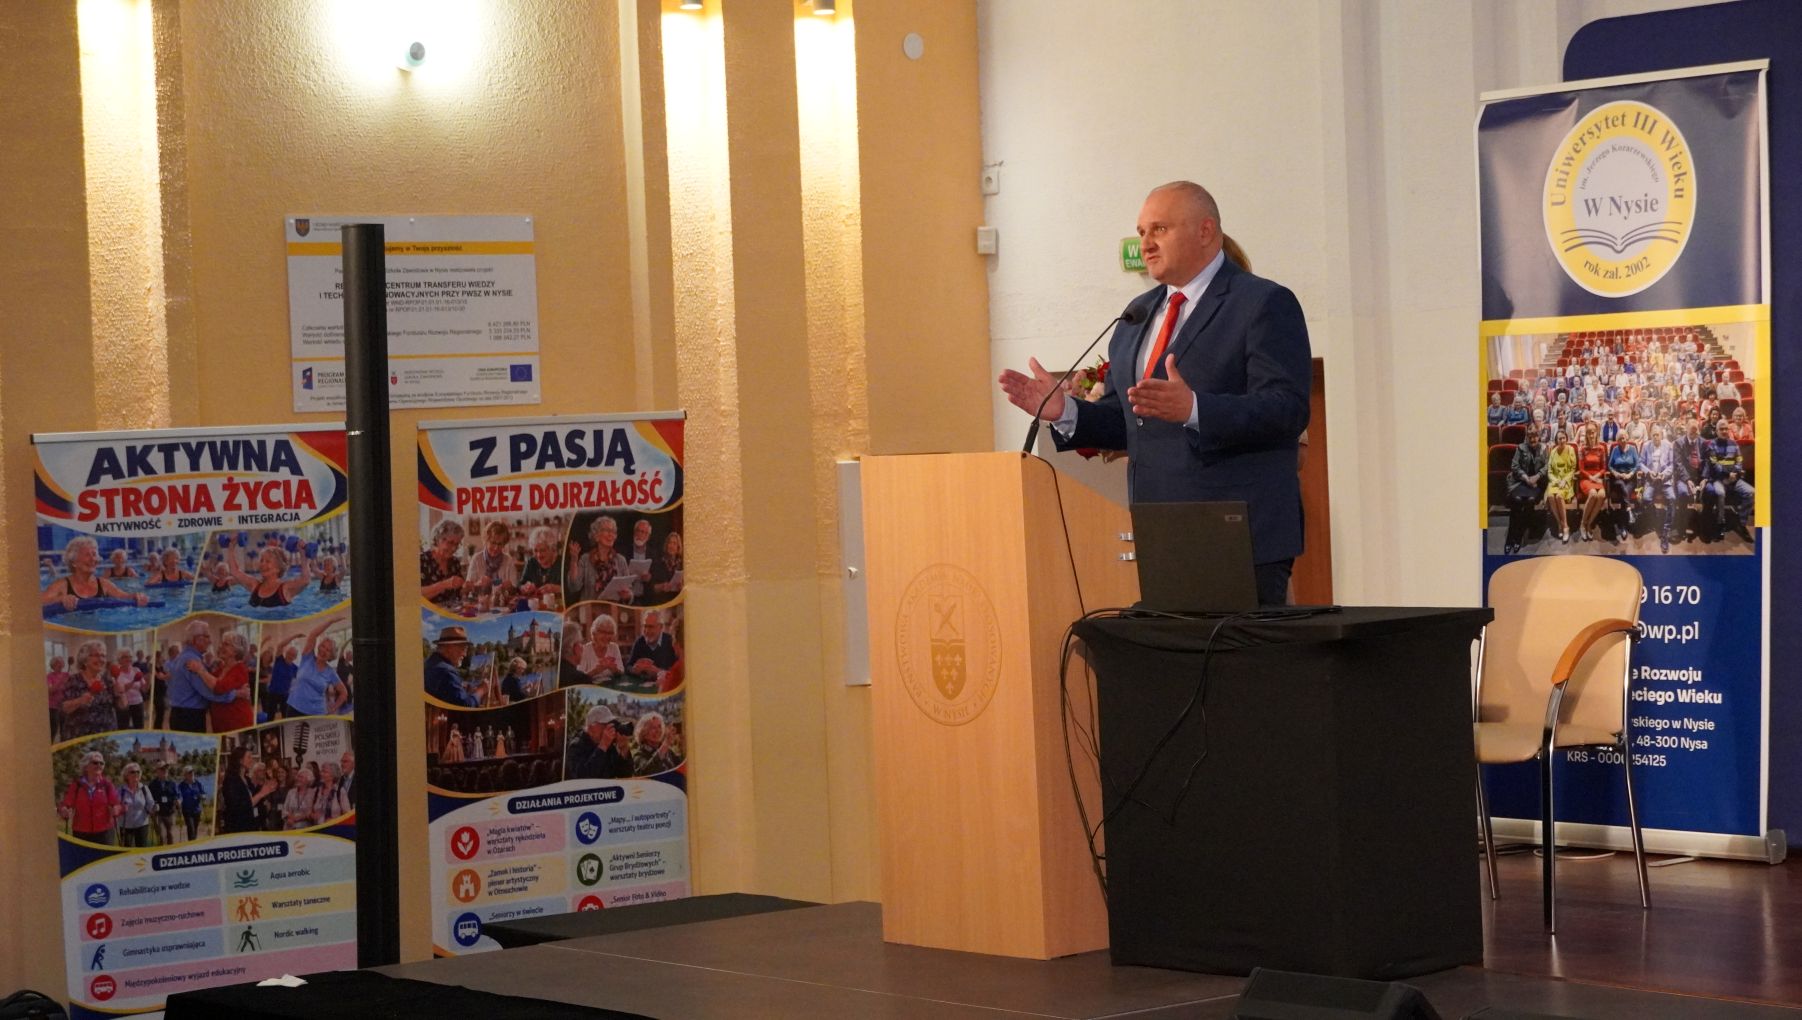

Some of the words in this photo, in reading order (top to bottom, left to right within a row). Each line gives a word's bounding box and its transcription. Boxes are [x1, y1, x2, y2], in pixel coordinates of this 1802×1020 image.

[1551, 113, 1626, 207] Uniwersytet
[1632, 111, 1658, 136] III
[1660, 129, 1688, 199] Wieku
[1583, 198, 1604, 218] W
[1608, 193, 1659, 220] Nysie
[1127, 244, 1139, 258] W
[1584, 260, 1601, 277] rok
[1625, 256, 1651, 278] 2002
[385, 281, 422, 290] CENTRUM
[423, 281, 467, 289] TRANSFERU
[468, 280, 496, 288] WIEDZY
[441, 289, 460, 298] PRZY
[461, 289, 482, 297] PWSZ
[484, 289, 490, 297] W
[492, 289, 513, 297] NYSIE
[86, 438, 304, 487] AKTYWNA
[469, 436, 498, 479] Z
[509, 428, 636, 476] PASJĄ
[77, 482, 216, 523] STRONA
[222, 476, 317, 512] ŻYCIA
[456, 484, 523, 515] PRZEZ
[529, 470, 663, 511] DOJRZAŁOŚĆ
[94, 517, 162, 533] AKTYWNOŚĆ
[177, 516, 223, 529] ZDROWIE
[237, 512, 301, 526] INTEGRACJA
[1652, 585, 1673, 605] 16
[1676, 585, 1701, 605] 70
[1641, 665, 1702, 685] Rozwoju
[1677, 688, 1723, 704] Wieku
[1671, 719, 1682, 729] w
[1683, 718, 1715, 732] Nysie
[1636, 735, 1678, 749] 48-300
[1681, 737, 1708, 751] Nysa
[1567, 751, 1589, 762] KRS
[515, 798, 562, 810] DZIAŁANIA
[563, 790, 617, 804] PROJEKTOWE
[159, 852, 216, 868] DZIAŁANIA
[217, 845, 281, 861] PROJEKTOWE
[270, 870, 287, 881] Aqua
[287, 868, 311, 878] aerobic
[119, 884, 160, 896] Rehabilitacja
[168, 881, 191, 891] wodzie
[271, 898, 303, 910] Warsztaty
[303, 895, 331, 906] taneczne
[121, 916, 143, 928] Zajęcia
[274, 928, 295, 939] Nordic
[295, 926, 319, 937] walking
[122, 944, 161, 957] Gimnastyka
[161, 940, 206, 952] usprawniająca
[124, 974, 187, 988] Międzypokoleniowy
[188, 970, 210, 981] wyjazd
[211, 966, 247, 977] edukacyjny
